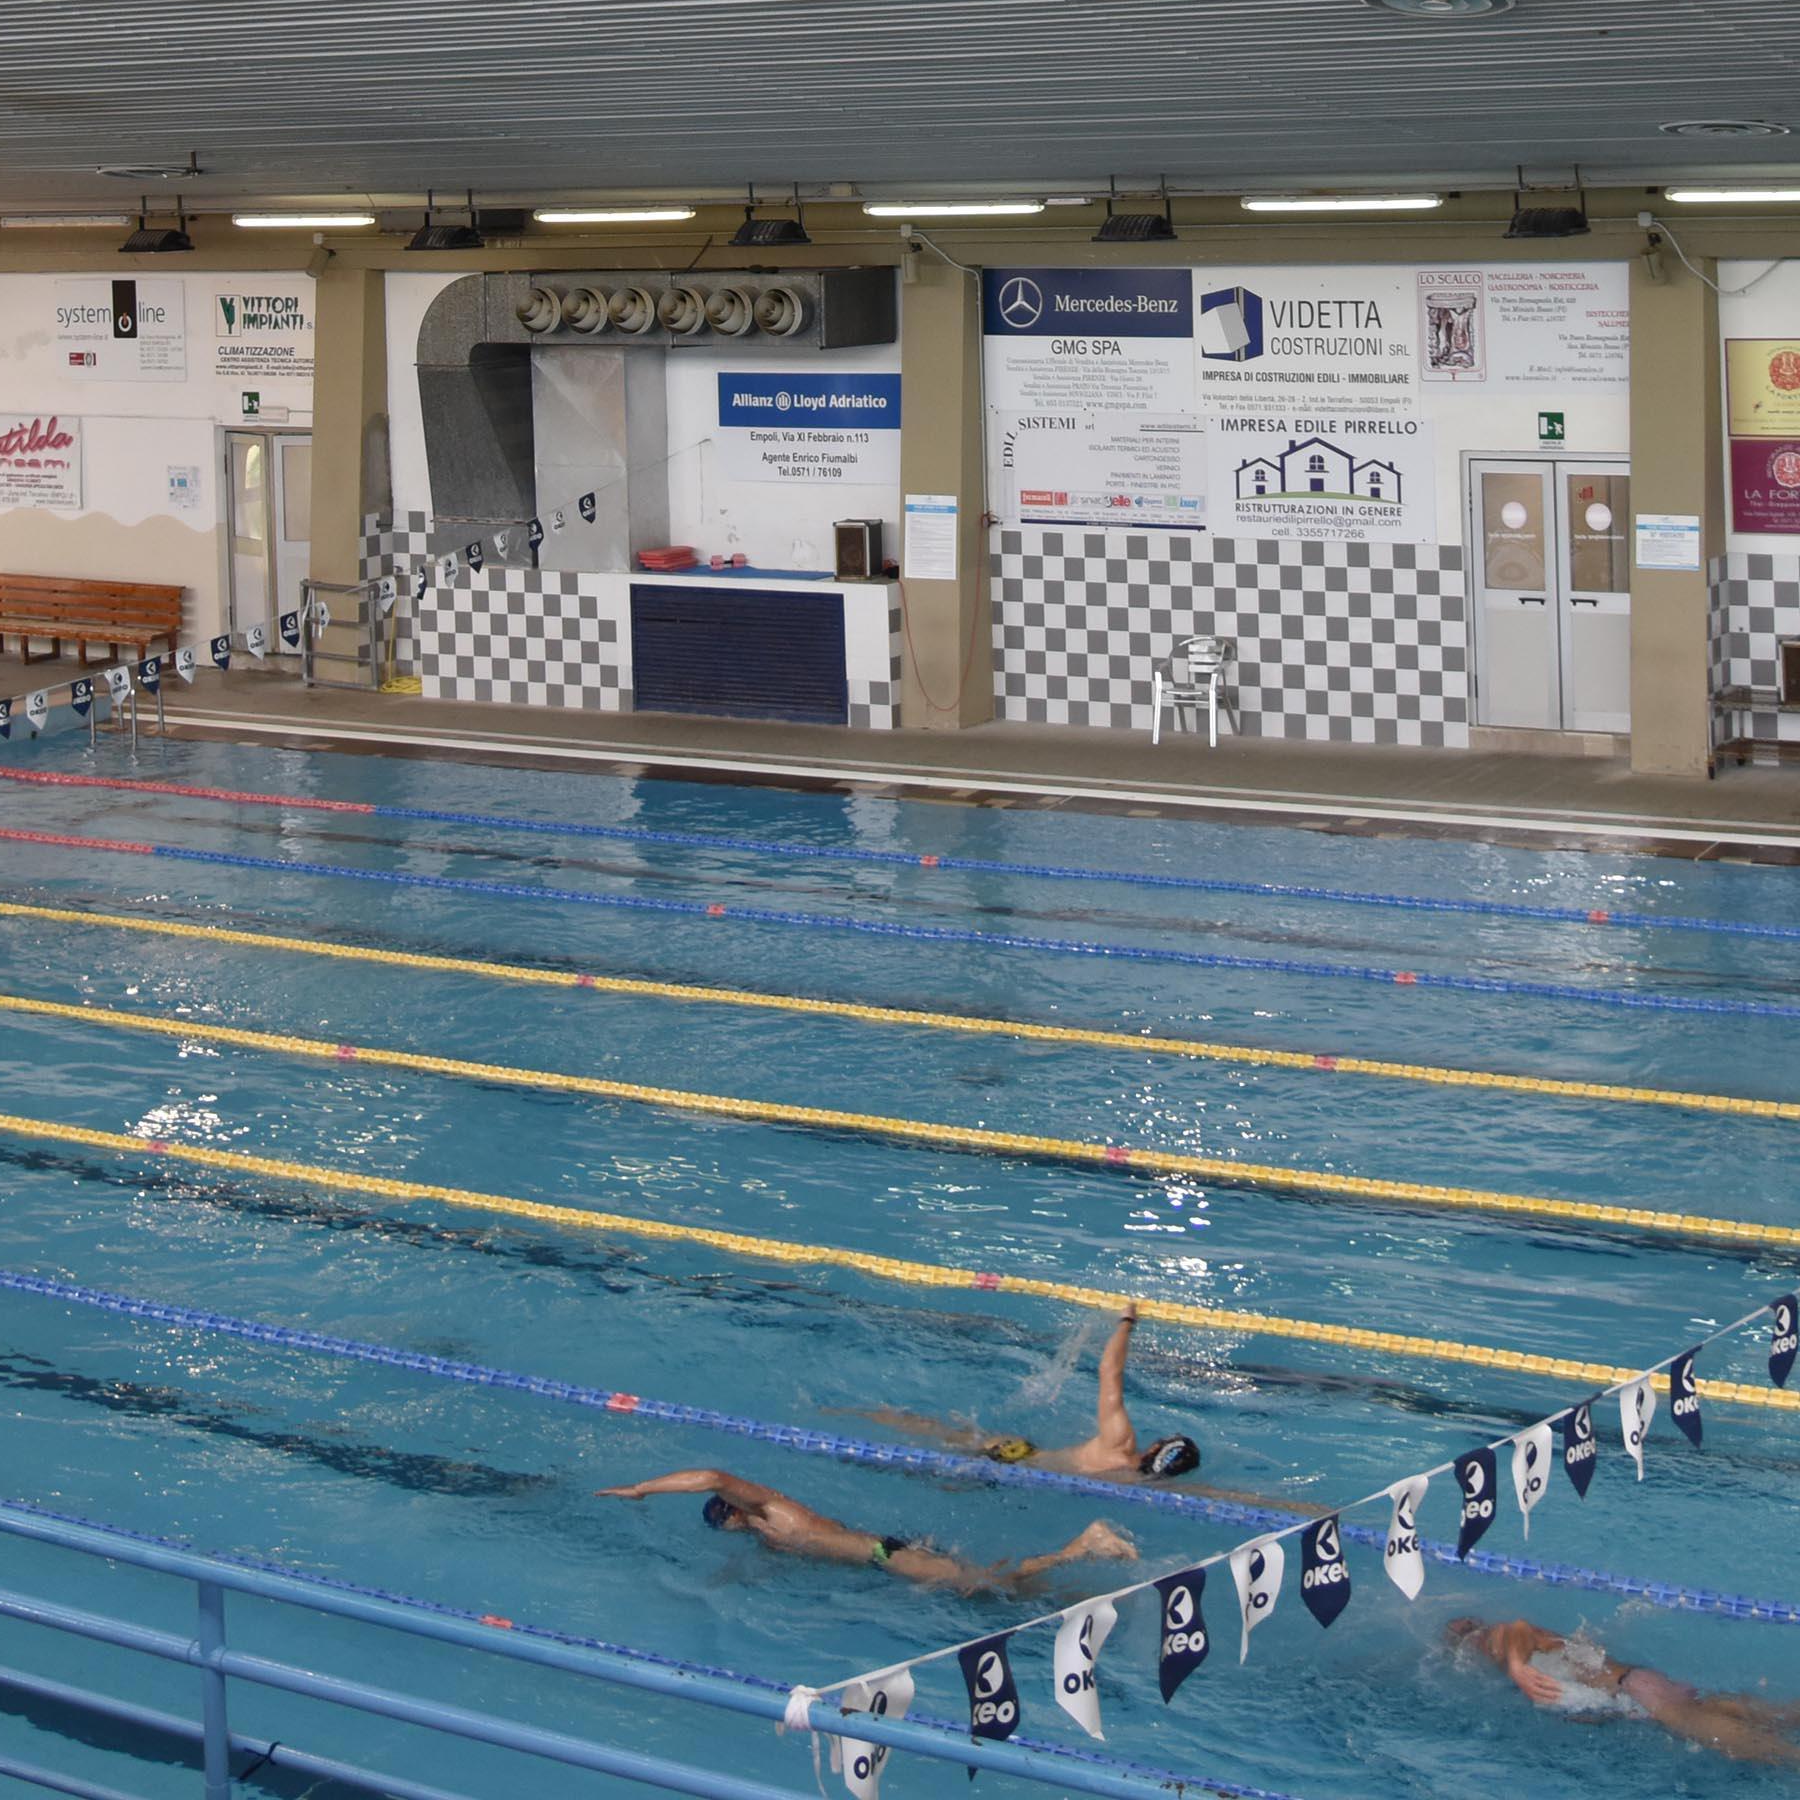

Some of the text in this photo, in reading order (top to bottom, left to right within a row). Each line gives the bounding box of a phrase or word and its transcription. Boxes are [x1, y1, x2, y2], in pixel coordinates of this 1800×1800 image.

[1420, 273, 1481, 285] LO SCALCO
[242, 296, 298, 313] VITTORI
[1055, 295, 1178, 313] Mercedes-Benz
[57, 301, 165, 328] system line
[242, 313, 304, 330] IMPIANTI
[1270, 300, 1382, 328] VIDETTA
[218, 346, 295, 356] CLIMATIZZAZIONE
[1051, 339, 1122, 356] GMG SPA
[1270, 336, 1410, 356] COSTRUZIONI SRL
[1202, 370, 1409, 385] IMPRESA DI COSTRUZIONI EDILI IMMOBILIARE
[732, 393, 887, 410] Allianz Lloyd Adriatico
[1018, 417, 1076, 431] SISTEMI
[1220, 418, 1418, 434] IMPRESA EDILE PIRRELLO
[750, 431, 869, 444] Empoli, Via XI Febbraio n.113
[1003, 430, 1018, 468] EDIL
[762, 452, 858, 464] Agente Enrico Fiumalbi
[777, 466, 842, 478] Tel.0571 76109
[1745, 490, 1762, 500] LA
[1235, 503, 1403, 517] RISTRUTTURAZIONI IN GENERE
[1235, 514, 1402, 527] restauriedilipirrello@gmail.com
